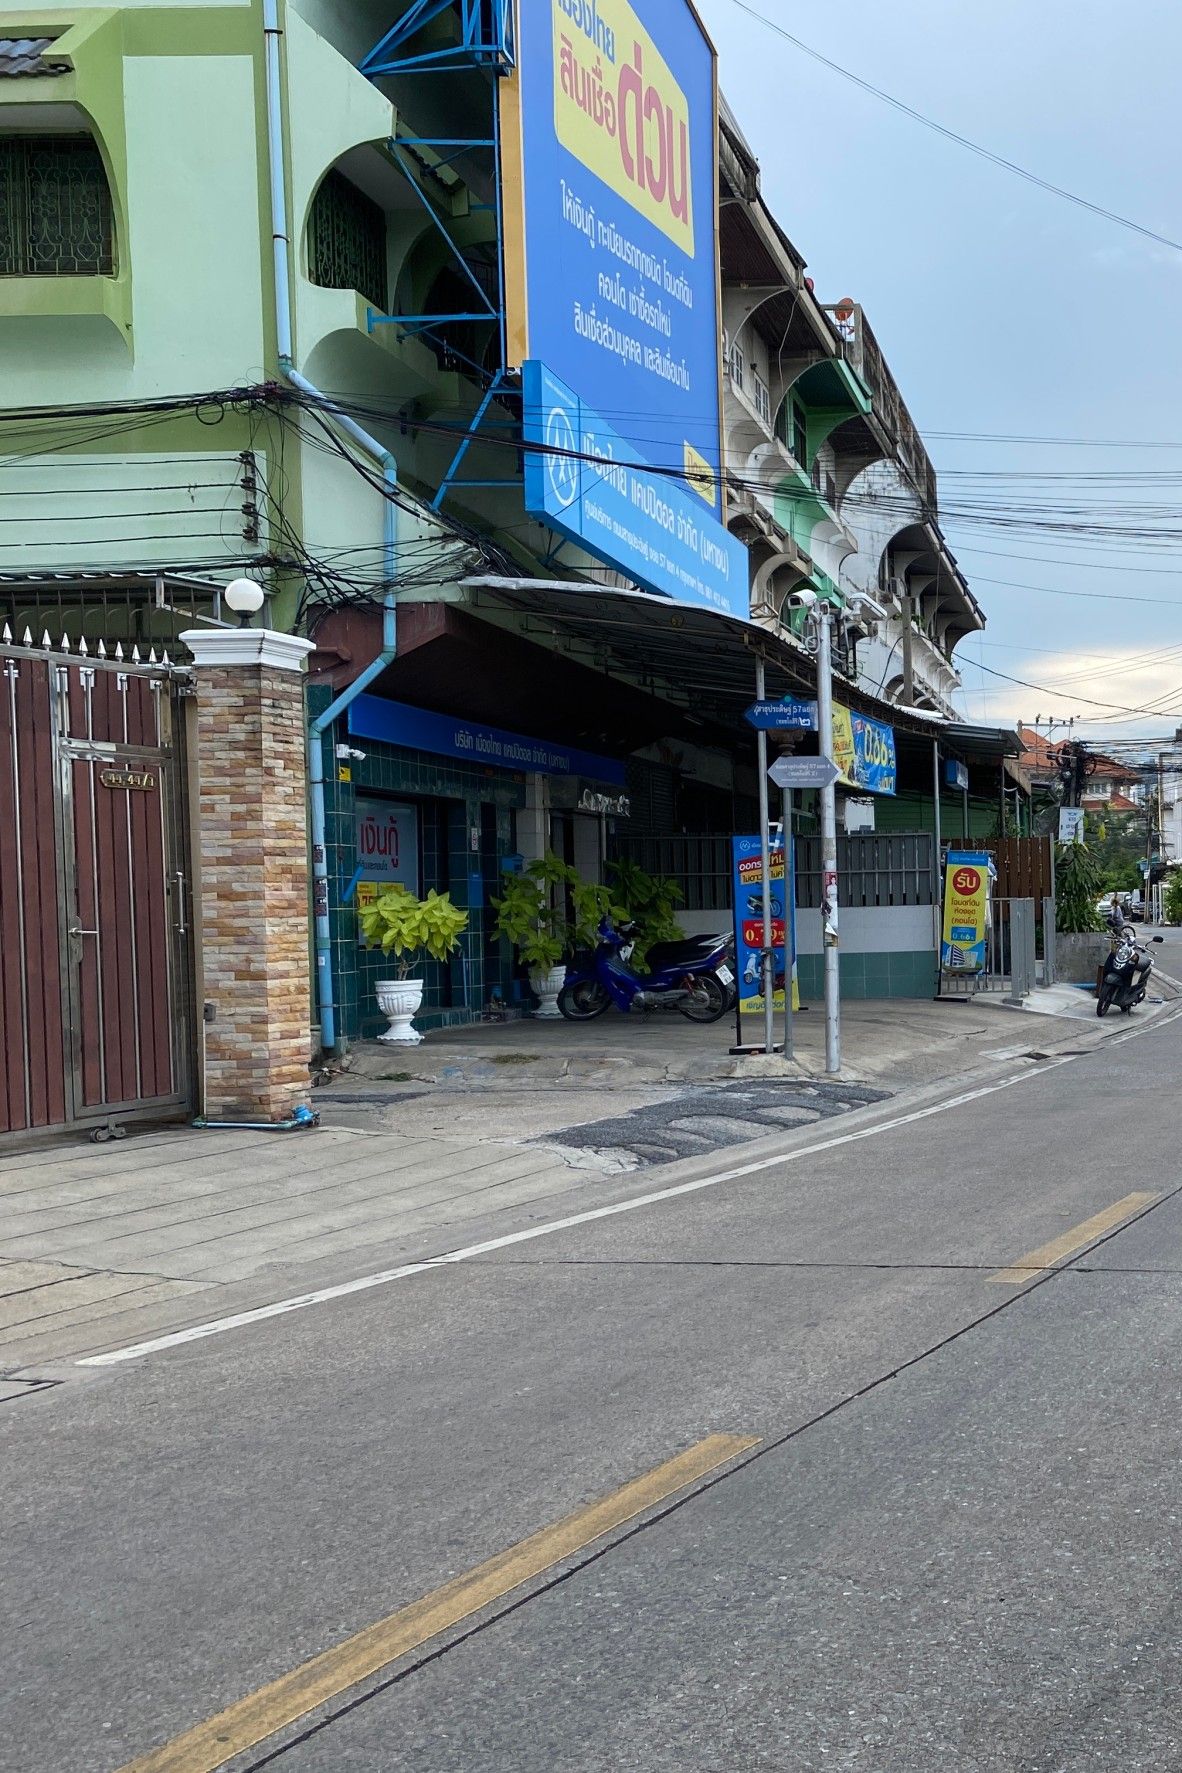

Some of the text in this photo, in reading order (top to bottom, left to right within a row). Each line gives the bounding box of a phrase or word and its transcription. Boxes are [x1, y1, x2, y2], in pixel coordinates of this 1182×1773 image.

[560, 32, 617, 138] สินเชื่อ
[617, 39, 689, 226] ด่วน
[560, 179, 693, 309] ให้เงินกู้ ทะเบียนรถทุกชนิด โฉนดที่ดิน
[574, 301, 642, 366] สินเชื่อส่วนบุคคล
[598, 272, 672, 338] คอนโด เช่าซื้อรถใหม่
[677, 508, 698, 552] จำกัด
[700, 530, 729, 582] (มหาชน)
[360, 815, 399, 868] เงินกู้
[956, 872, 977, 889] รับ
